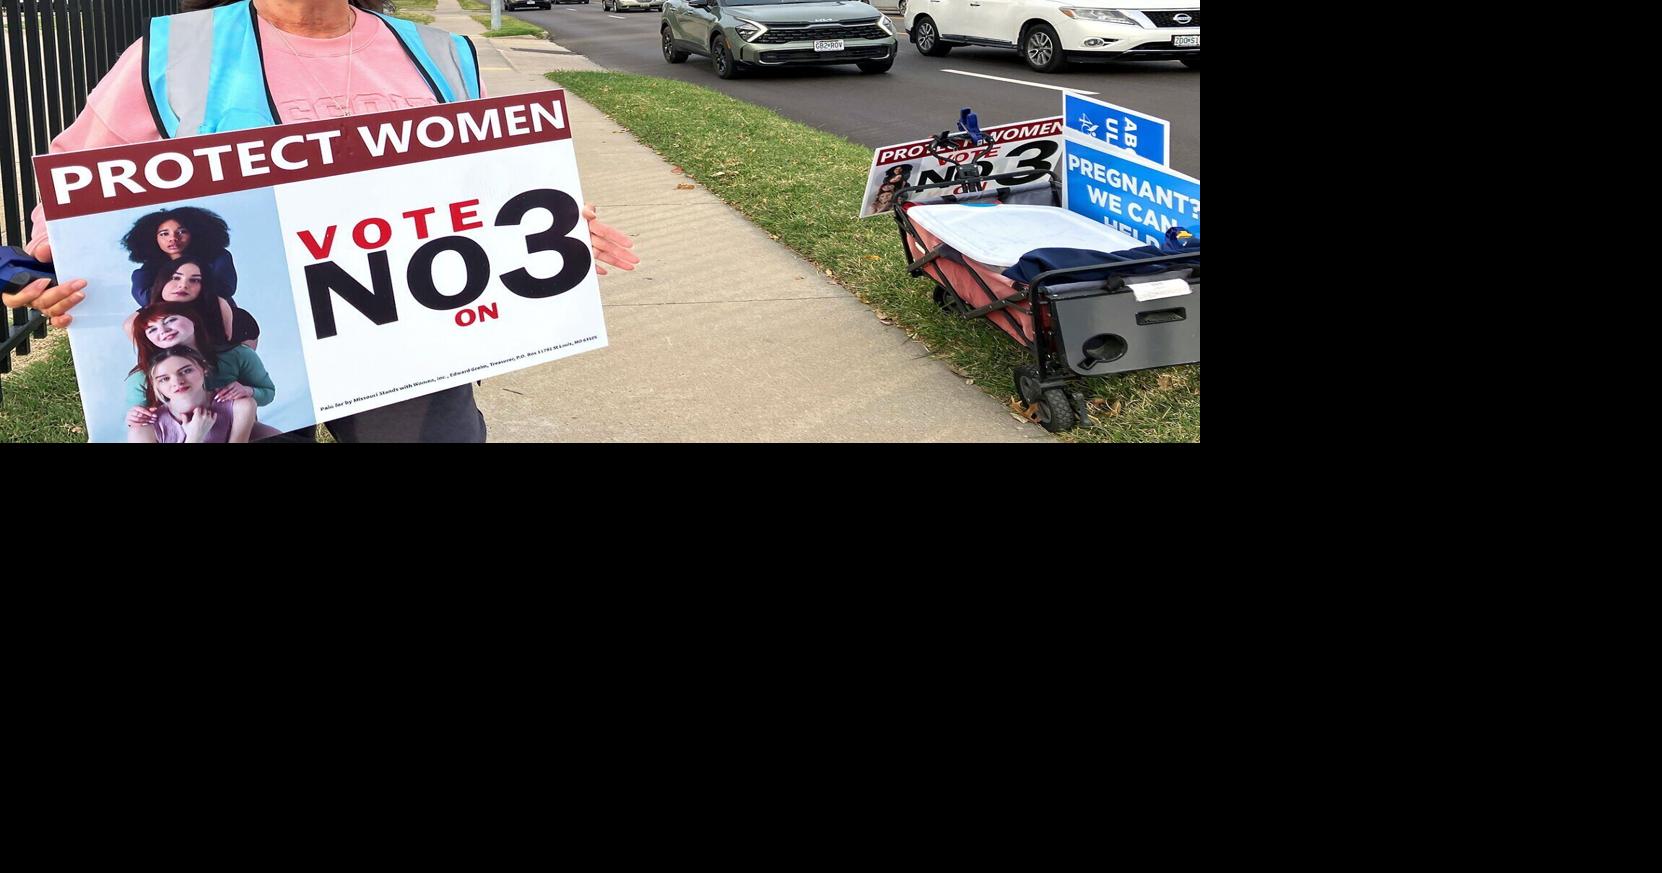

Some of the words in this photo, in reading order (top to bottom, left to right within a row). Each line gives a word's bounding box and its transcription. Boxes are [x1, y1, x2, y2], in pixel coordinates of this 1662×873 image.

[51, 130, 341, 204] PROTECT
[358, 100, 565, 157] WOMEN
[1068, 153, 1200, 219] PREGNANT?
[1087, 184, 1122, 215] WE
[1127, 202, 1178, 234] CAN
[297, 199, 483, 260] VOTE
[304, 235, 490, 339] NO
[494, 188, 591, 299] 3
[455, 302, 499, 326] ON
[400, 383, 413, 391] with
